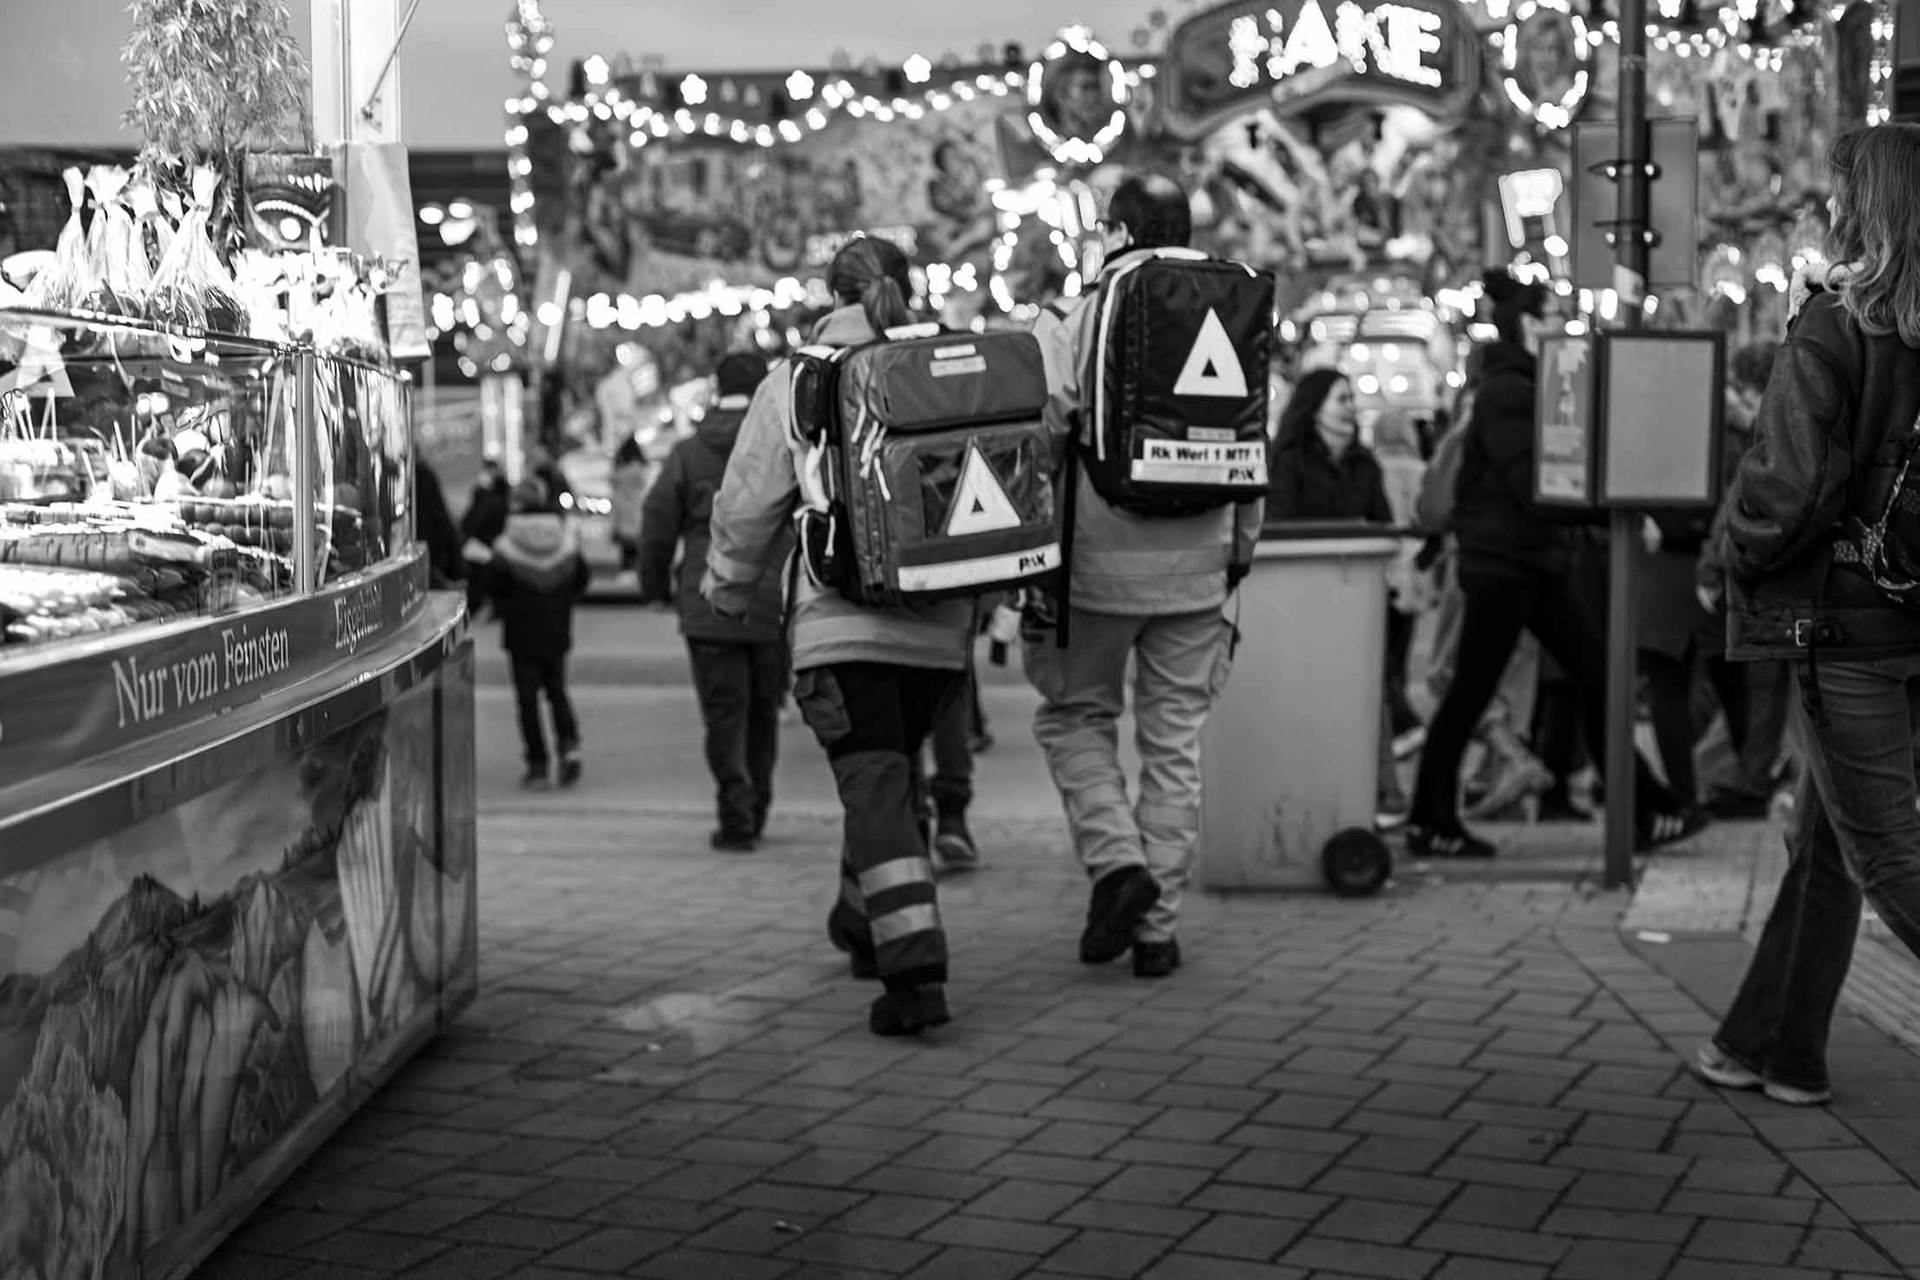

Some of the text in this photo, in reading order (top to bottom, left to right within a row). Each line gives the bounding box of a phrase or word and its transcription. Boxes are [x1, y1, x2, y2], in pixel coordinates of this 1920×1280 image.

[111, 624, 290, 729] Nur vom Feinsten
